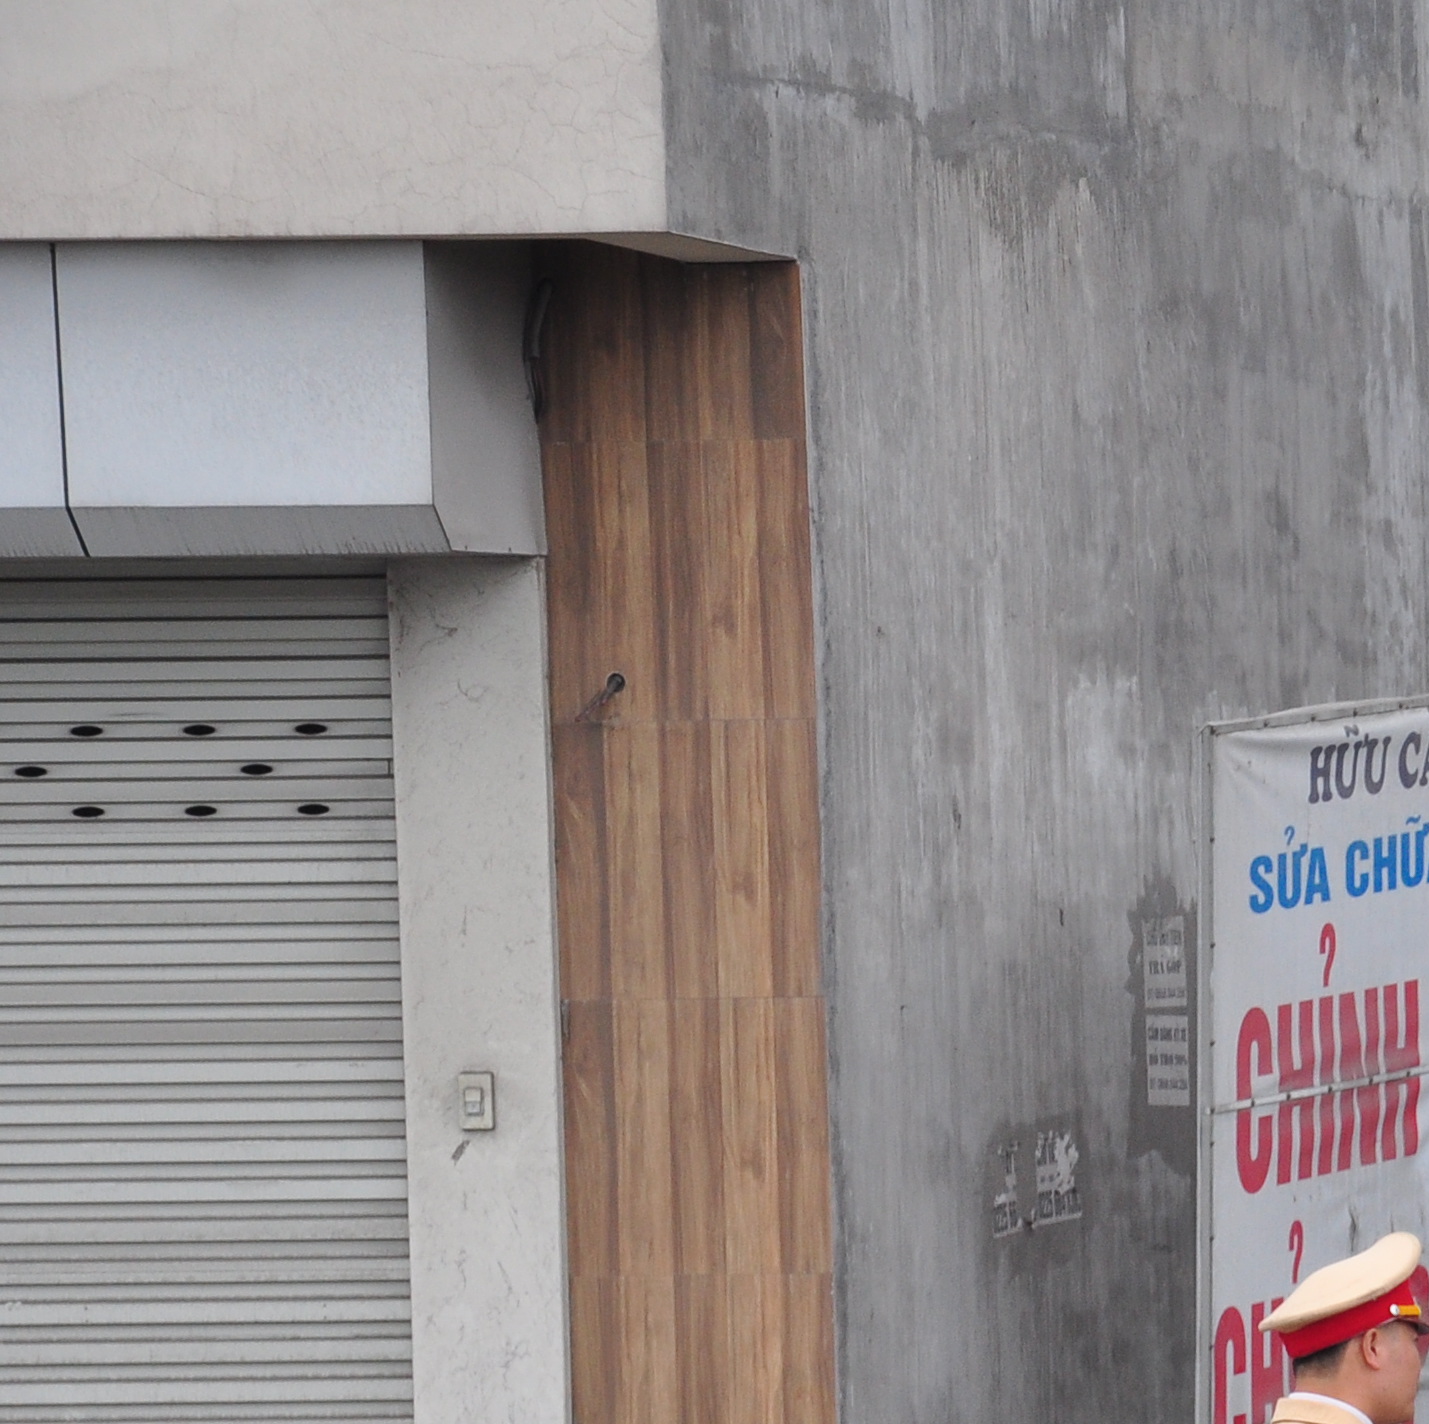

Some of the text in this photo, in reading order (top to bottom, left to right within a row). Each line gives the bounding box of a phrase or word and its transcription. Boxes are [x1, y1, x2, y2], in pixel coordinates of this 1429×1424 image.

[1308, 723, 1392, 804] HỮU
[1248, 825, 1332, 914] SỬA
[1236, 922, 1420, 1195] CHỈNH
